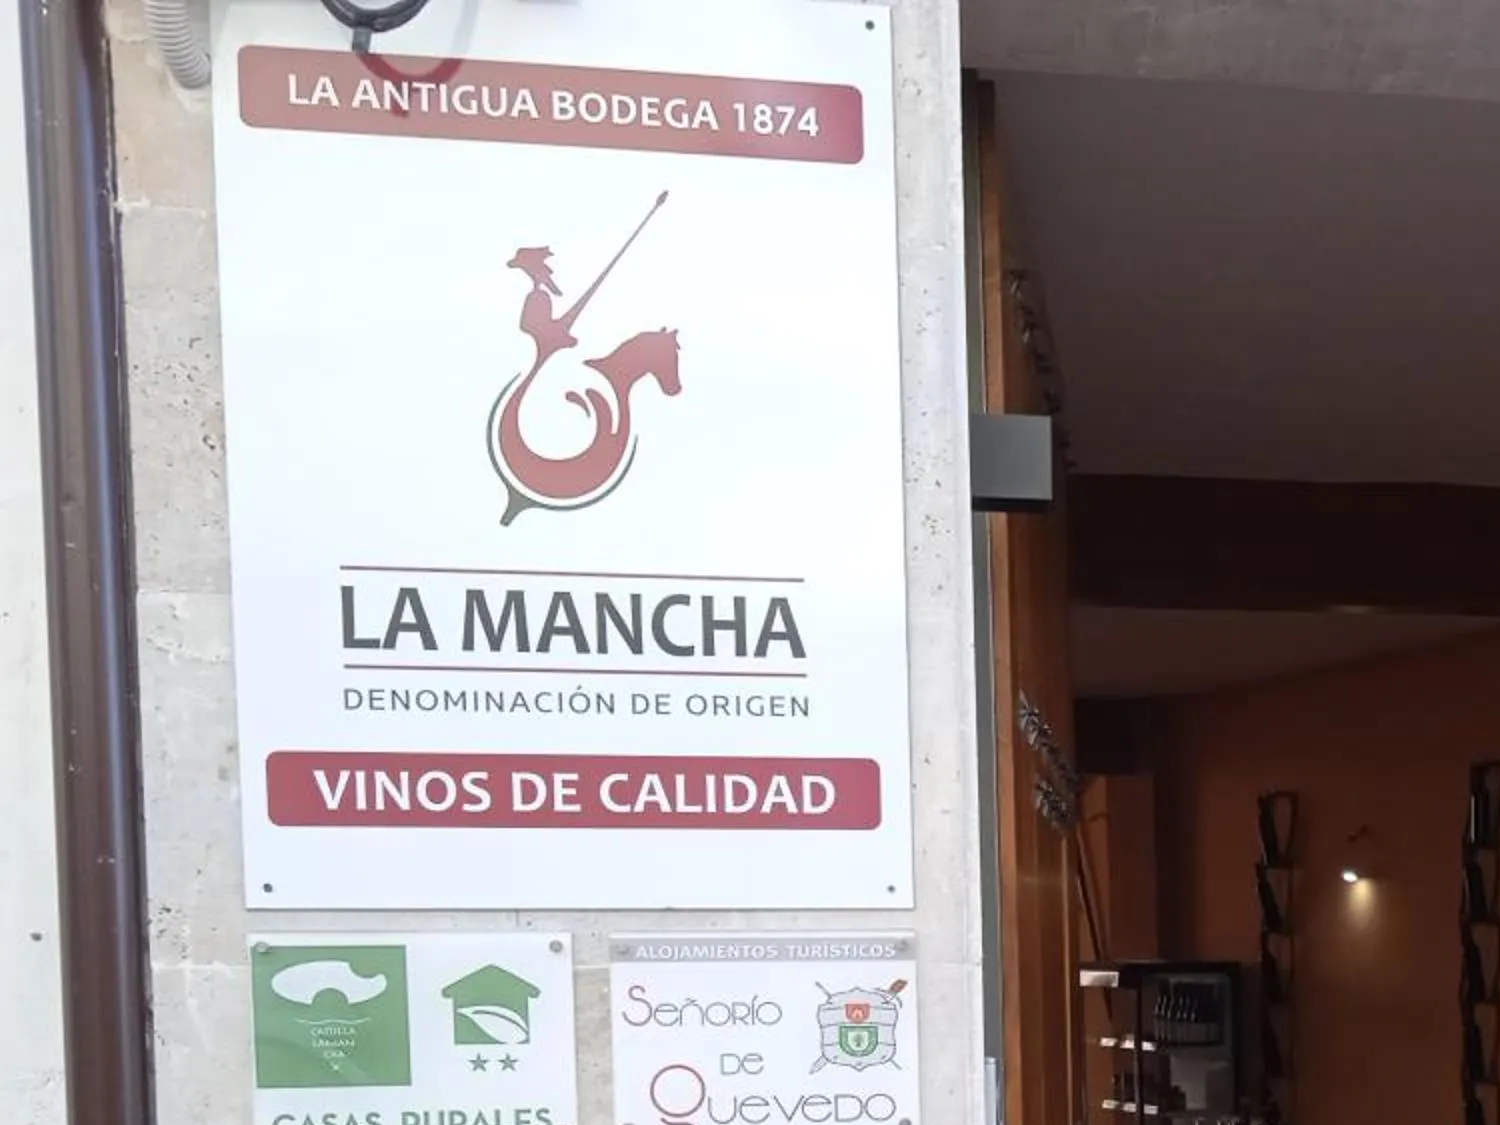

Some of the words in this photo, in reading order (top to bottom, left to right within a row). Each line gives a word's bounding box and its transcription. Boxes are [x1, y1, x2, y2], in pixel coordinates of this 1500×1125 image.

[286, 73, 341, 109] LA
[351, 76, 541, 120] ANTIGUA
[552, 89, 720, 131] BODEGA
[732, 101, 820, 138] 1874
[340, 585, 438, 653] LA
[461, 588, 807, 659] MANCHA
[343, 684, 616, 716] DENOMINACIÓN
[630, 692, 674, 716] DE
[685, 693, 811, 719] ORIGEN
[313, 768, 492, 813] VINOS
[511, 771, 582, 814] DE
[600, 772, 836, 816] CALIDAD
[635, 944, 779, 960] ALOJAMIENTOS
[788, 942, 897, 959] TURÍSTICOS
